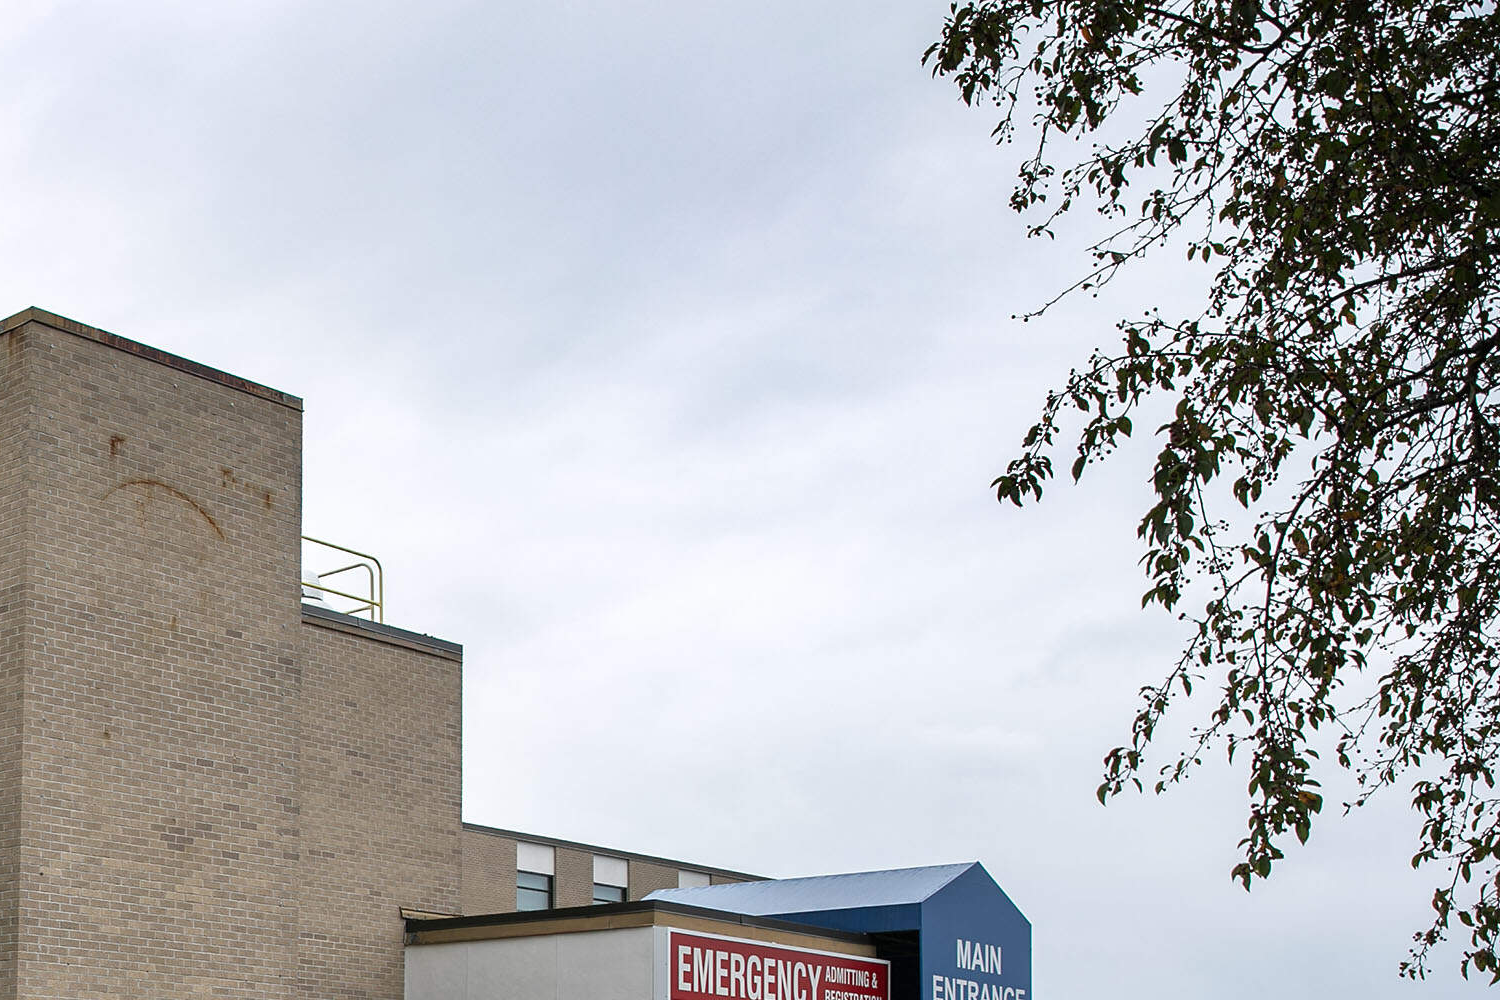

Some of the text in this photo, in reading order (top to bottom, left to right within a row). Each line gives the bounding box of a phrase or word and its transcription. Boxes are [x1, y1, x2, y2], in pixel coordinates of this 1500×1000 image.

[956, 938, 1003, 975] MAIN
[824, 965, 879, 988] ADMITTING &
